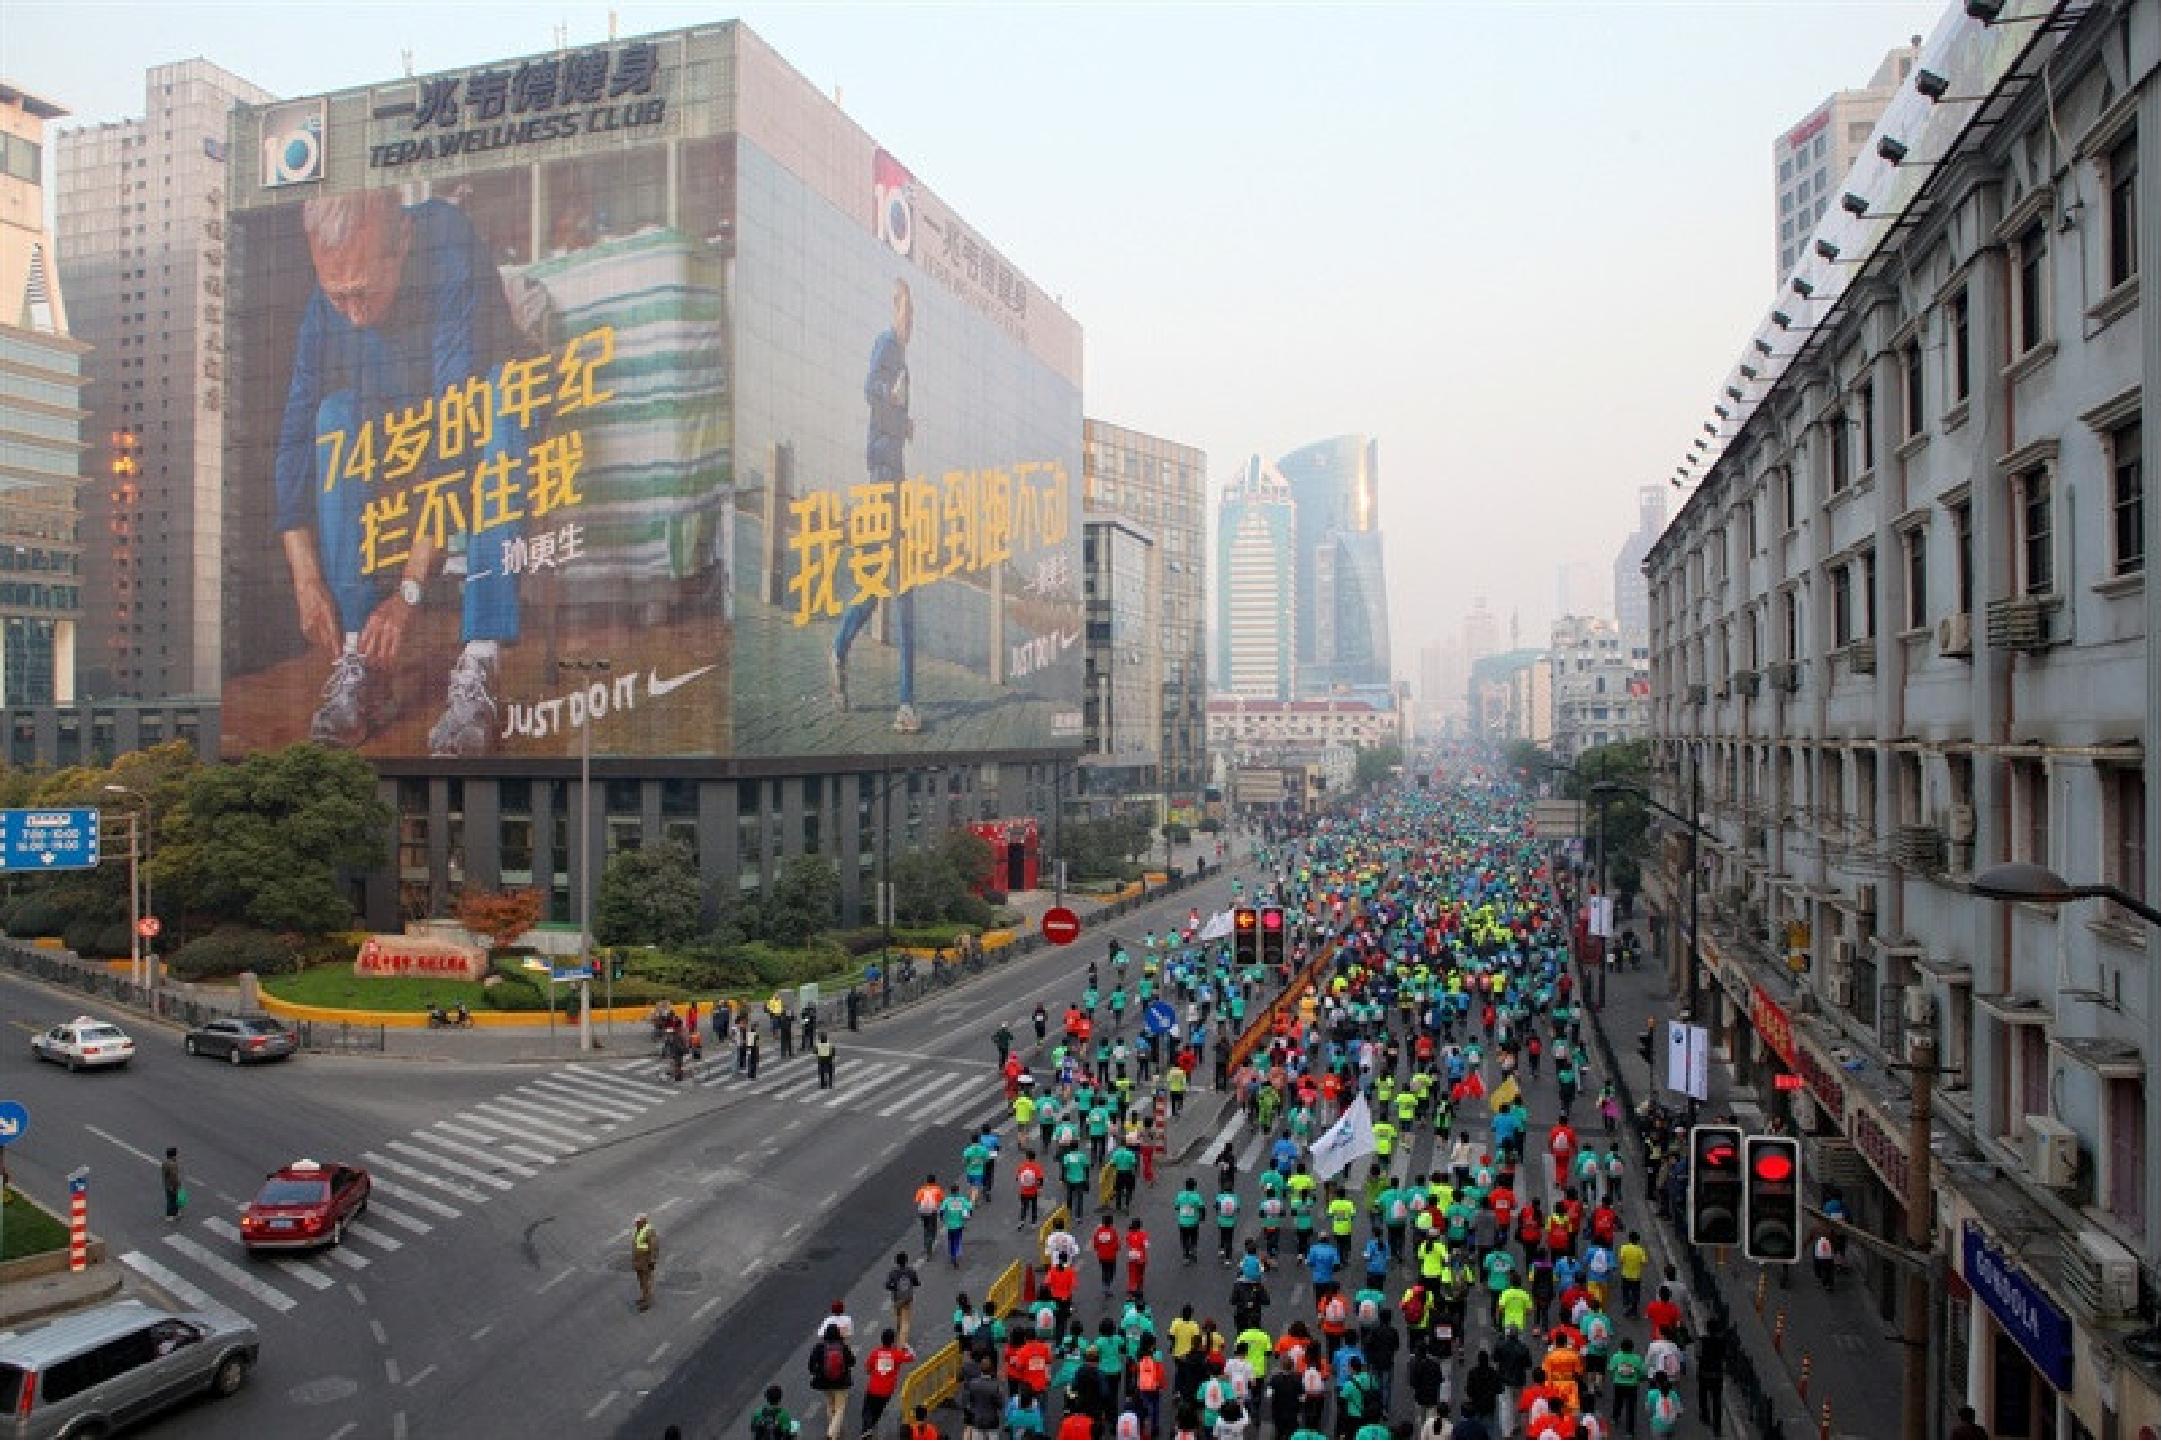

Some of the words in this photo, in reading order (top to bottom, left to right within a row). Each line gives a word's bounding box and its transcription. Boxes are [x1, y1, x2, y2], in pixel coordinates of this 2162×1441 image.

[369, 139, 433, 168] TERA
[436, 112, 580, 158] WELLNESS
[586, 100, 666, 132] CLUB
[316, 326, 616, 492] 74岁的年纪
[360, 432, 584, 574] 拦不住我
[502, 695, 563, 739] JUST
[568, 684, 606, 726] DO
[612, 672, 638, 710] IT
